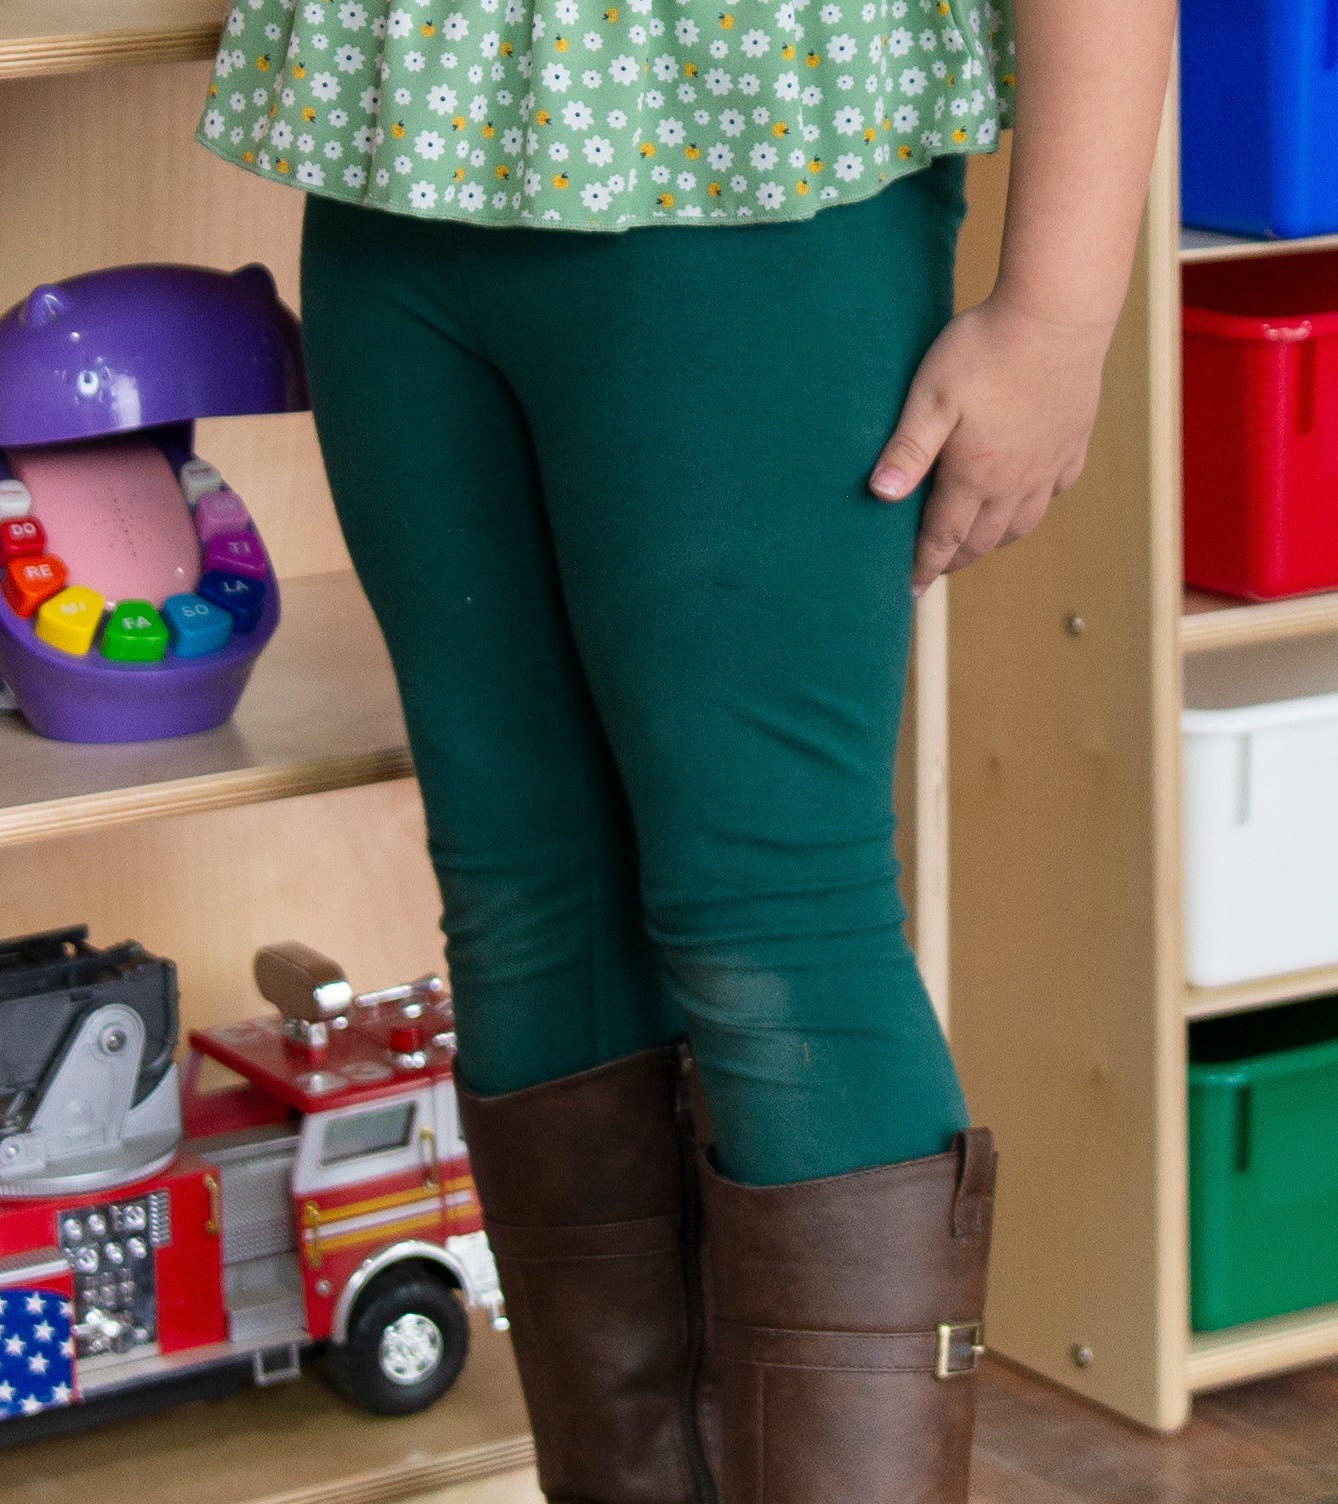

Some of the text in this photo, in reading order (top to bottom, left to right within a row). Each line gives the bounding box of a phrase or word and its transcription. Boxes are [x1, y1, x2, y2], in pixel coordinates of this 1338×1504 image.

[10, 522, 37, 539] DO
[24, 563, 54, 579] RE
[223, 579, 249, 593] LA
[60, 600, 87, 615] MI
[182, 603, 209, 618] SO
[121, 615, 152, 630] FA
